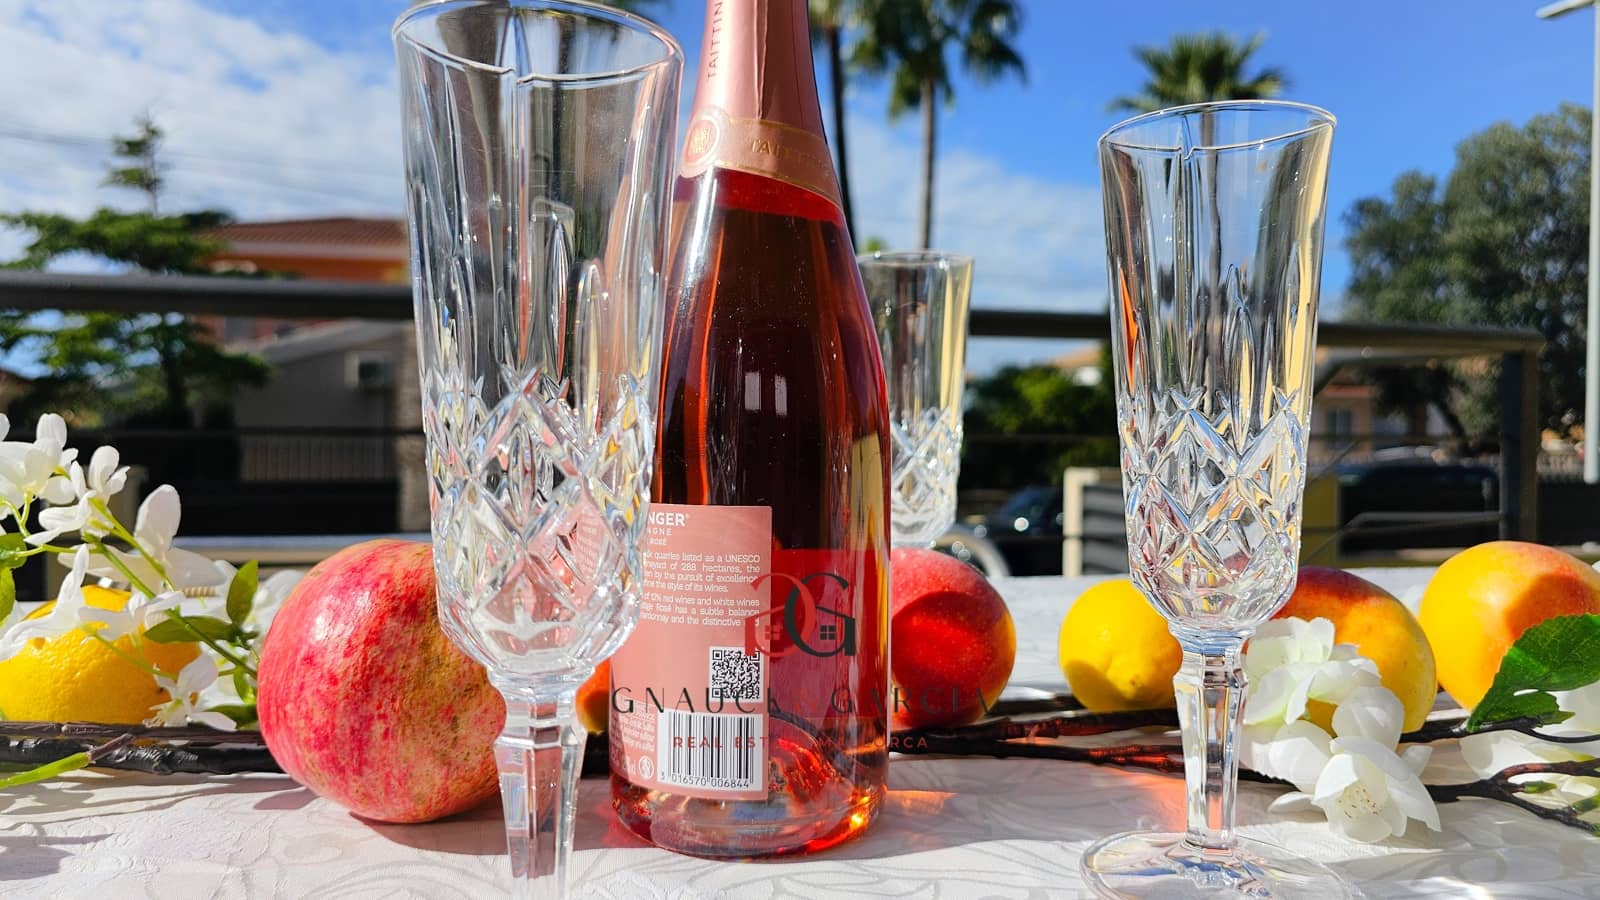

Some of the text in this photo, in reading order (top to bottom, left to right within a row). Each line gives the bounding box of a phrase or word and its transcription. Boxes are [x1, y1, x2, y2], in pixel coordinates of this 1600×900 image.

[725, 554, 760, 563] UNESCO
[736, 597, 760, 606] wines
[671, 773, 708, 787] 016570
[710, 778, 750, 789] 006844
